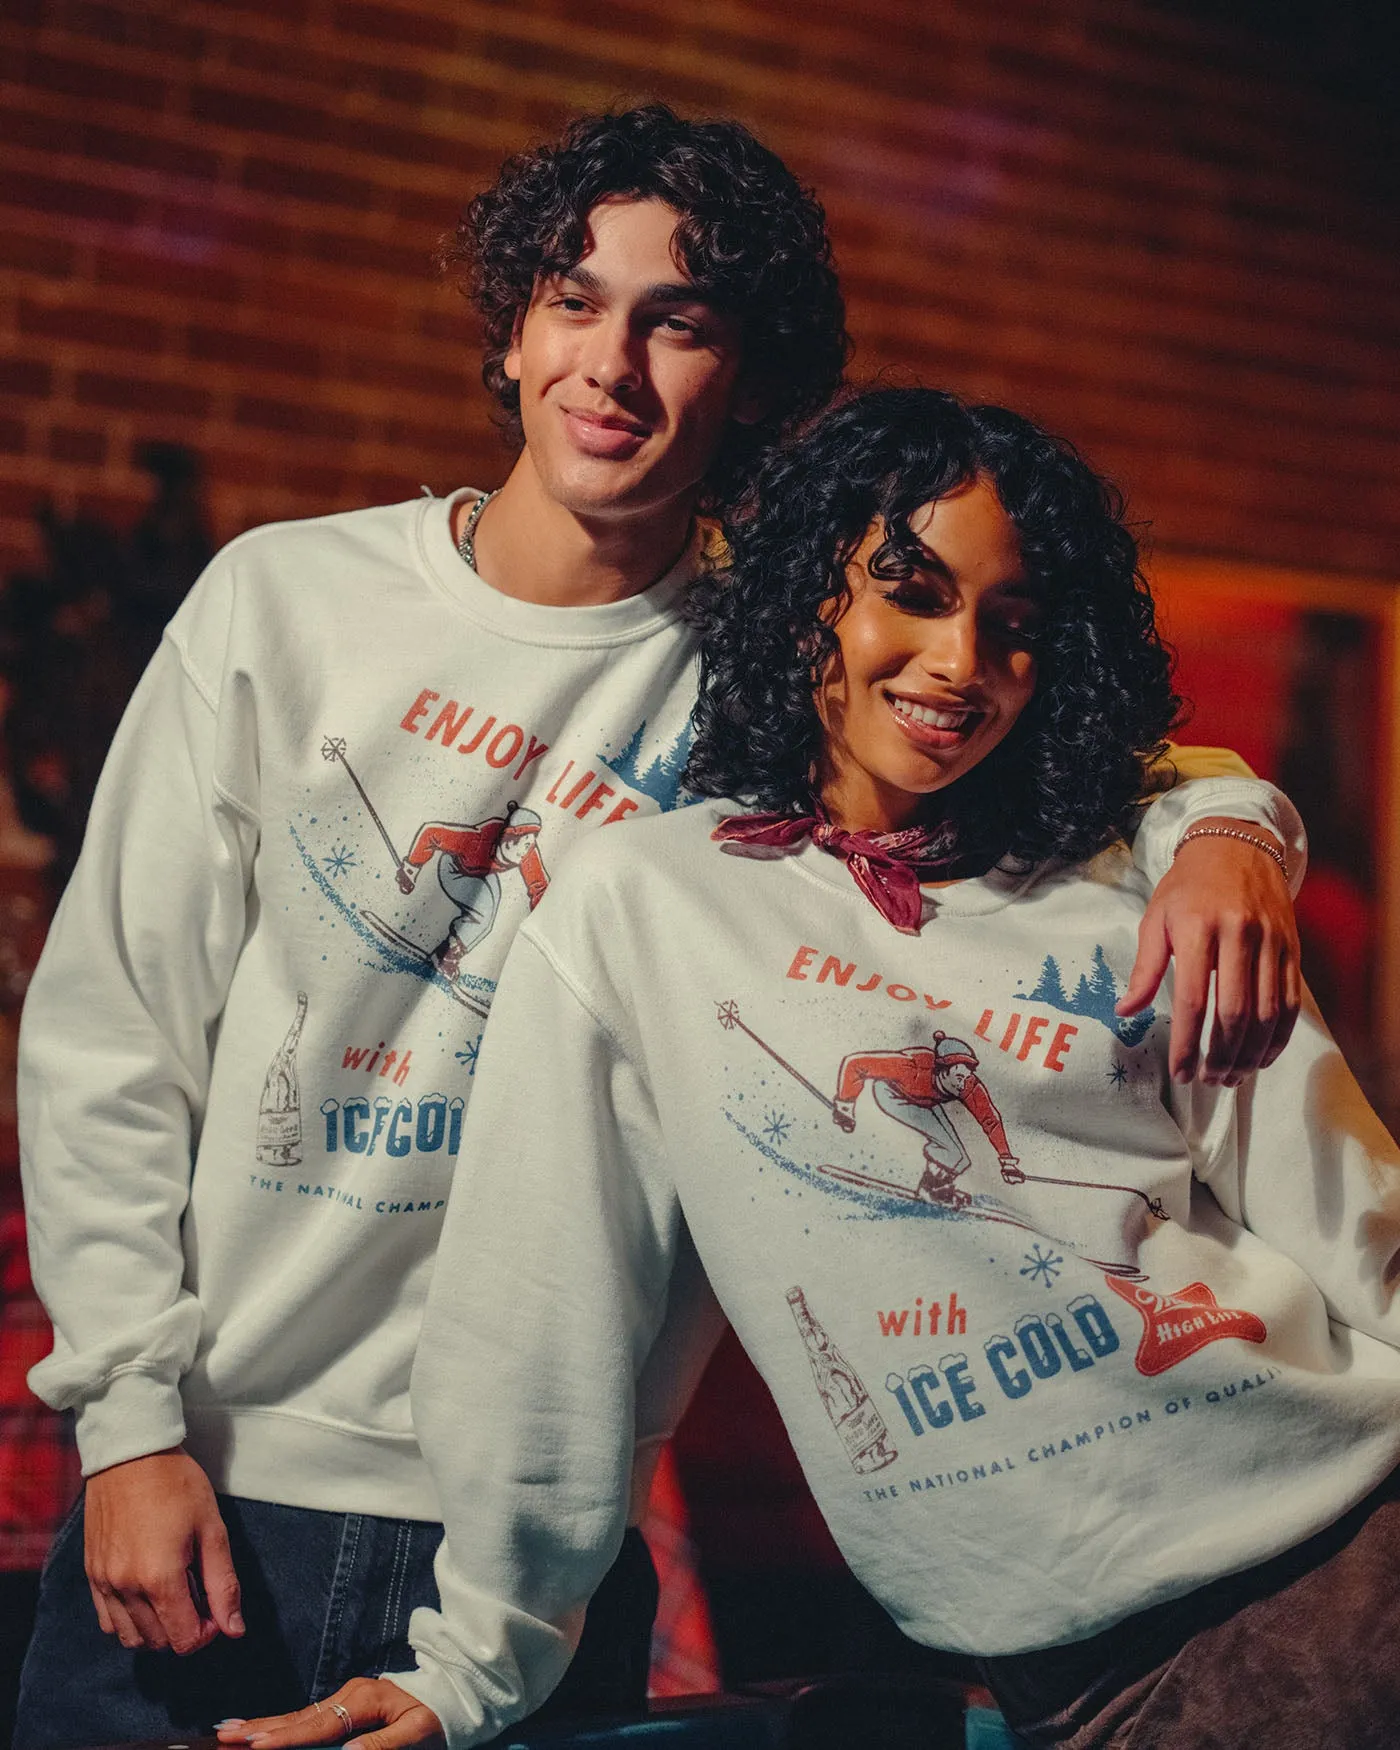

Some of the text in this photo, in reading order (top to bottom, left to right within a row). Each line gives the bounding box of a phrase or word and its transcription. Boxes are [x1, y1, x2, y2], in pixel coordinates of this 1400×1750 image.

[400, 687, 549, 781] ENJOY
[786, 945, 1079, 1073] ENJOY LIFE
[341, 1041, 412, 1087] with
[250, 1175, 284, 1192] THE
[877, 1292, 968, 1337] with
[885, 1352, 987, 1437] ICE
[983, 1294, 1120, 1400] COLD
[863, 1365, 1282, 1502] THE NATIONAL CHAMPION OF QUALI
